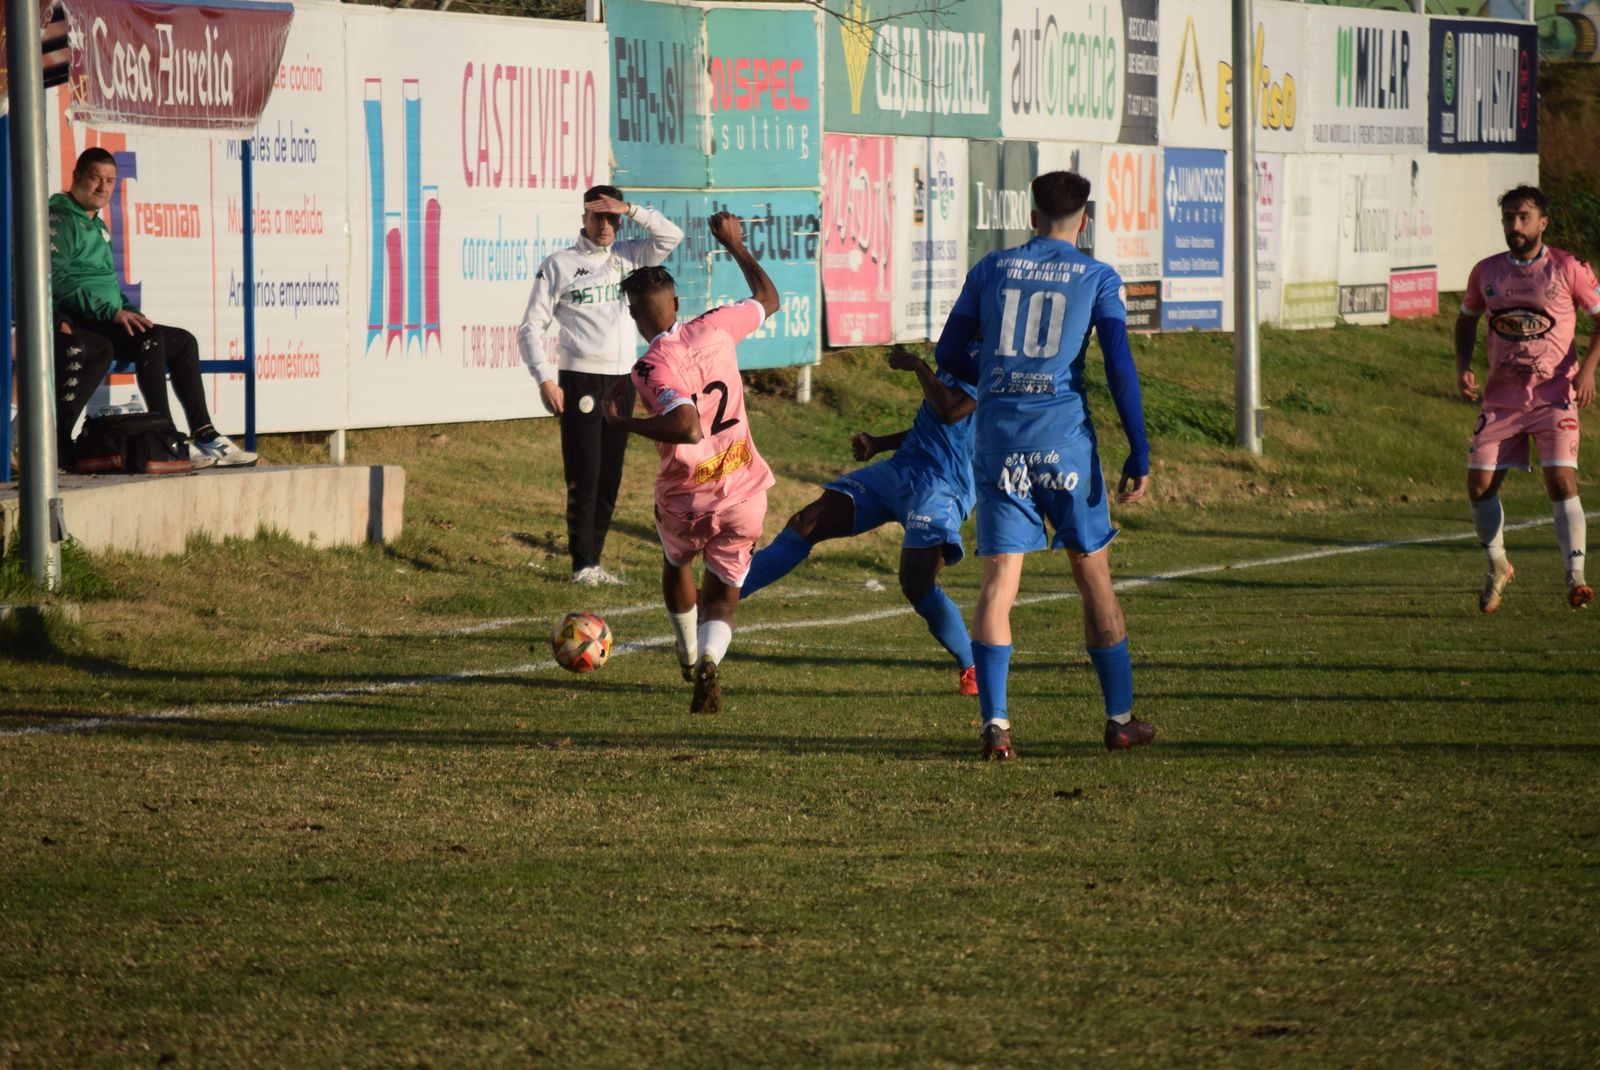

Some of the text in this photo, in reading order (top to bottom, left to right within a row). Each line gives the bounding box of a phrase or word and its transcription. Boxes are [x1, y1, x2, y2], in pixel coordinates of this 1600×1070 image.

[91, 17, 234, 107] Casa Aurelia
[289, 54, 323, 92] cocina
[693, 56, 810, 112] NSPEC
[876, 24, 990, 119] CAJA RURAL
[1355, 27, 1410, 110] MILAR
[226, 115, 317, 164] Mubles de baño
[461, 61, 596, 190] CASTILVIEJO
[228, 191, 324, 235] Mubles a medida
[1106, 151, 1159, 233] SOLA
[463, 213, 528, 281] corredores
[1072, 263, 1086, 274] DE
[279, 261, 340, 318] empotrados
[783, 296, 811, 338] 133
[994, 288, 1066, 358] 10
[1044, 449, 1060, 464] de
